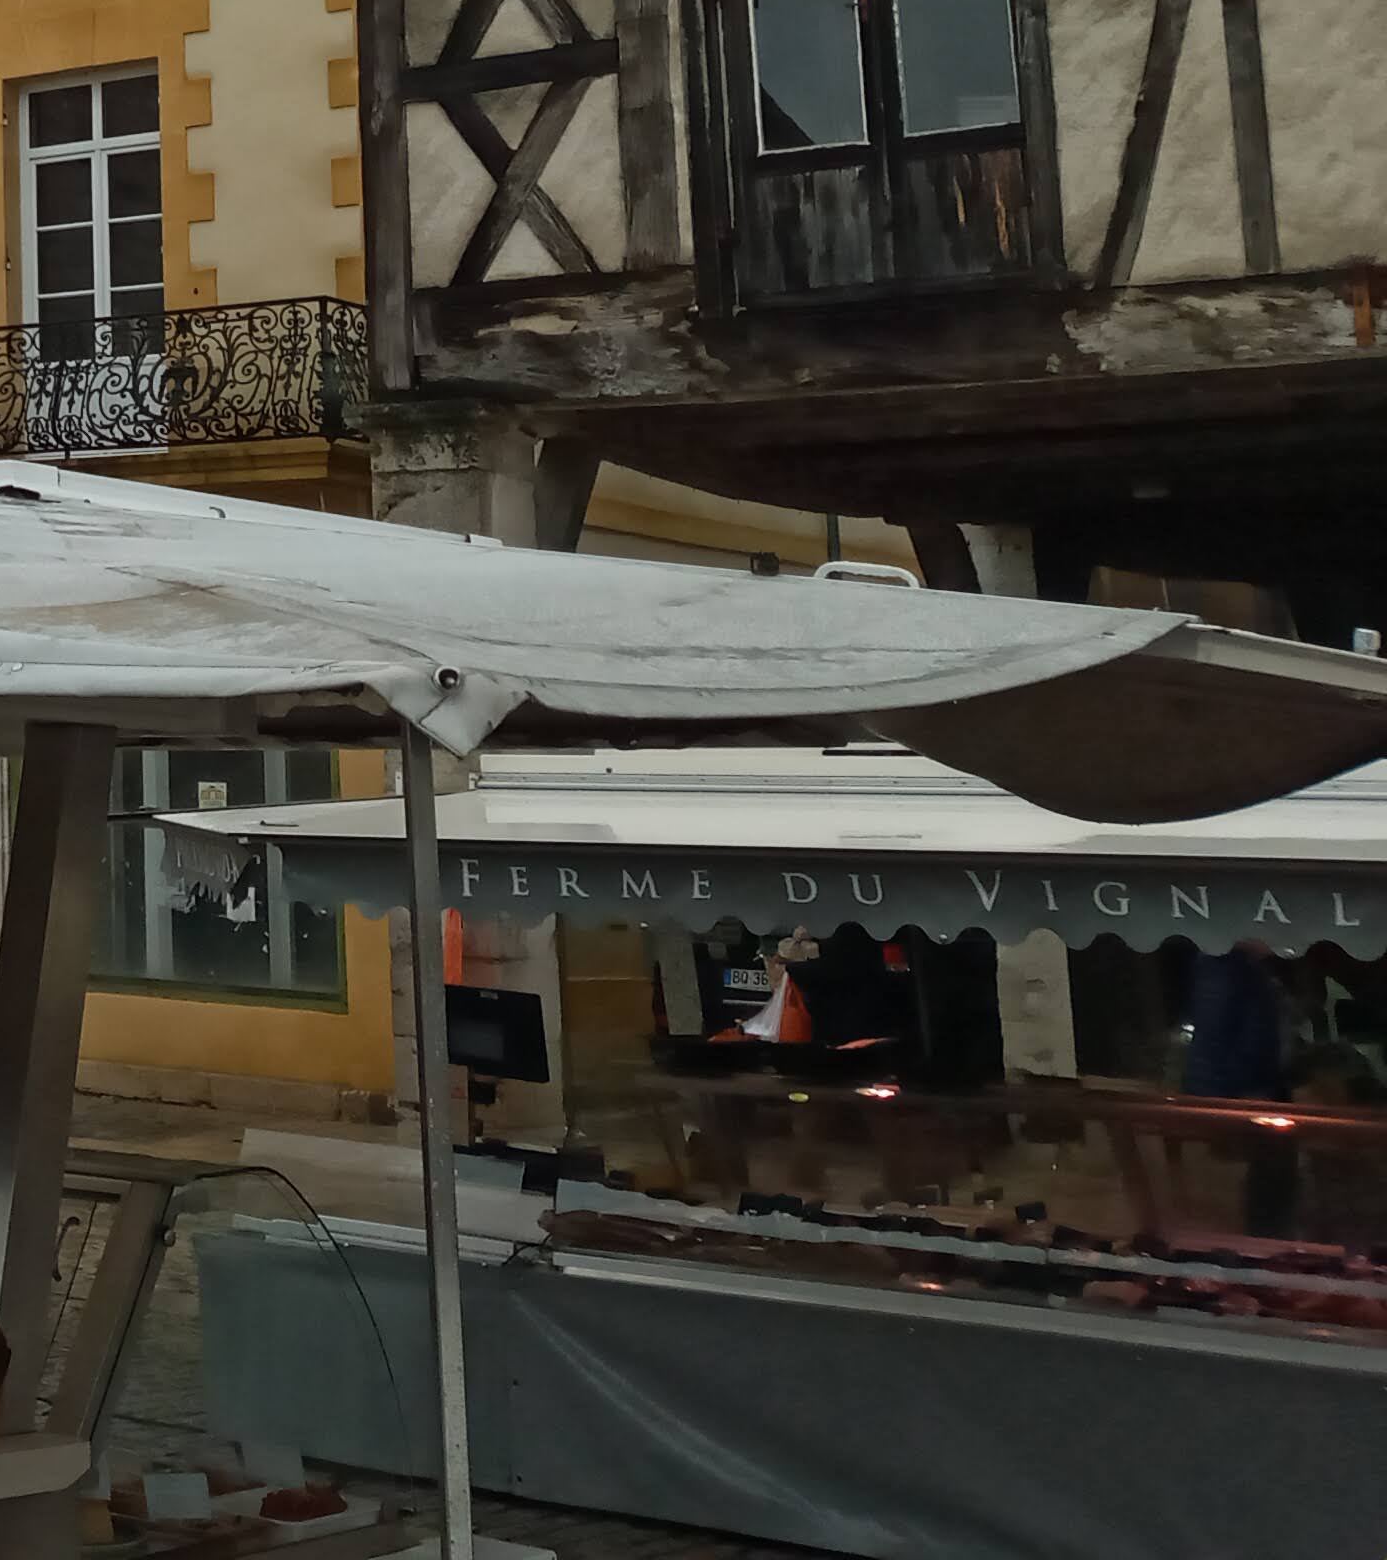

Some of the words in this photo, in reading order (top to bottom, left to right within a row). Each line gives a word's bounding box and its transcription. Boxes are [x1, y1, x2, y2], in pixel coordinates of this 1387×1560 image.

[459, 858, 714, 900] FERME
[781, 871, 885, 906] DU
[964, 869, 1361, 928] VIGNAL
